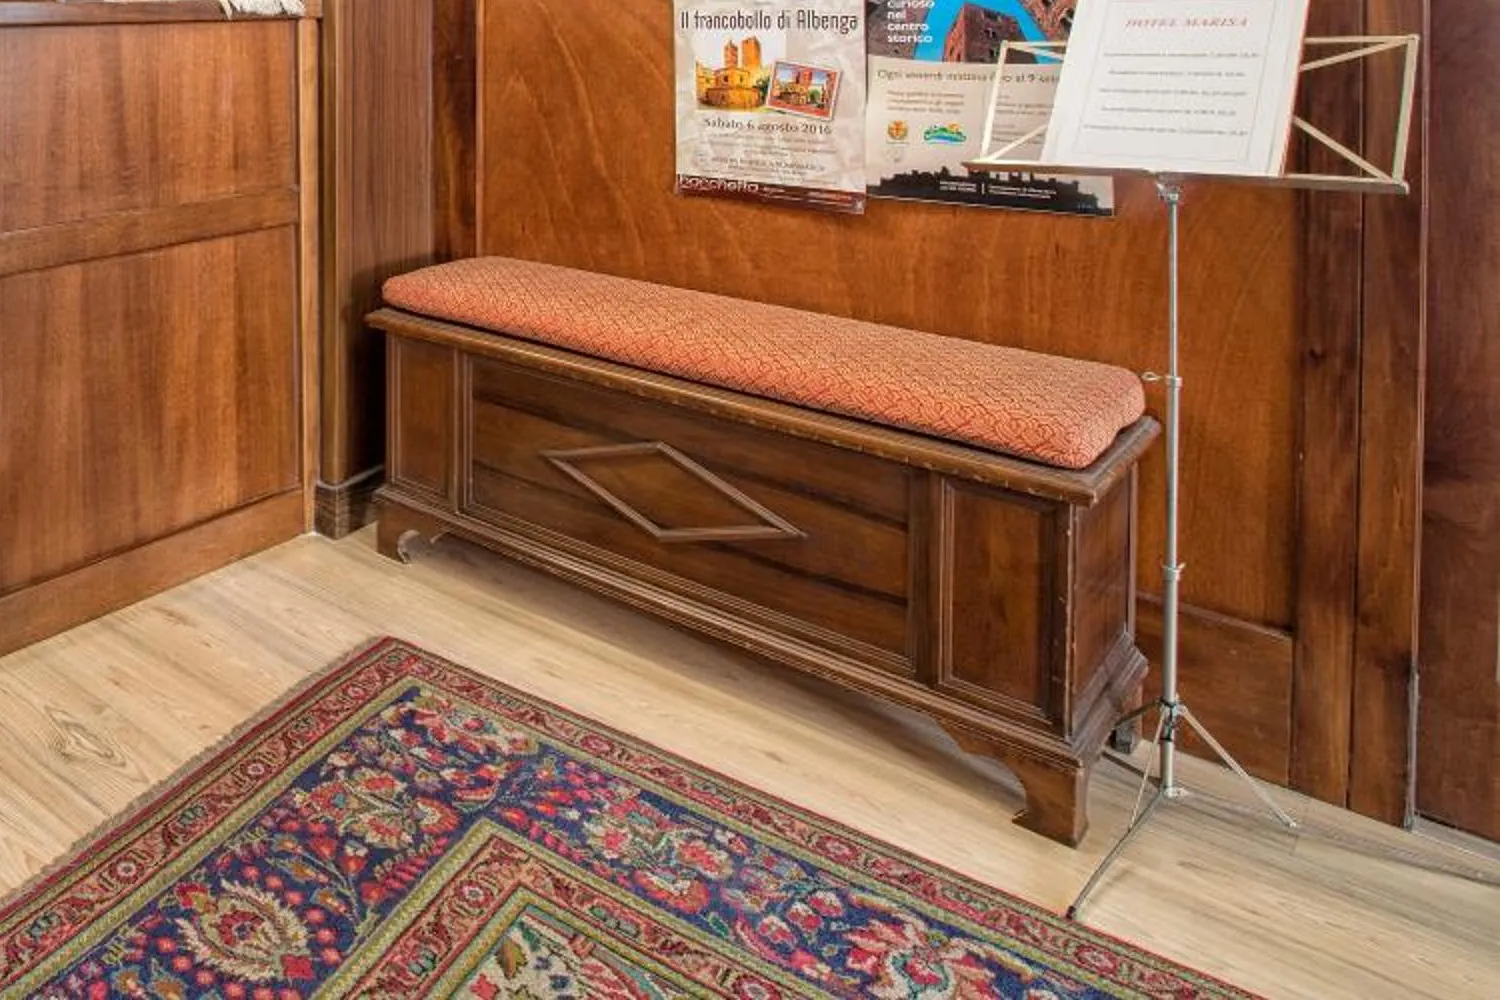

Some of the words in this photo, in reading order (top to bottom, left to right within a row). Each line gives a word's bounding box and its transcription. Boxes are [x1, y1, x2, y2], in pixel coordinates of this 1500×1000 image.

[681, 11, 689, 29] Il
[694, 10, 772, 30] francobollo
[777, 9, 792, 29] di
[797, 9, 858, 34] Albenga
[887, 33, 933, 44] storico
[703, 117, 743, 130] Sabato
[757, 121, 798, 134] agosto
[799, 123, 833, 136] 2016
